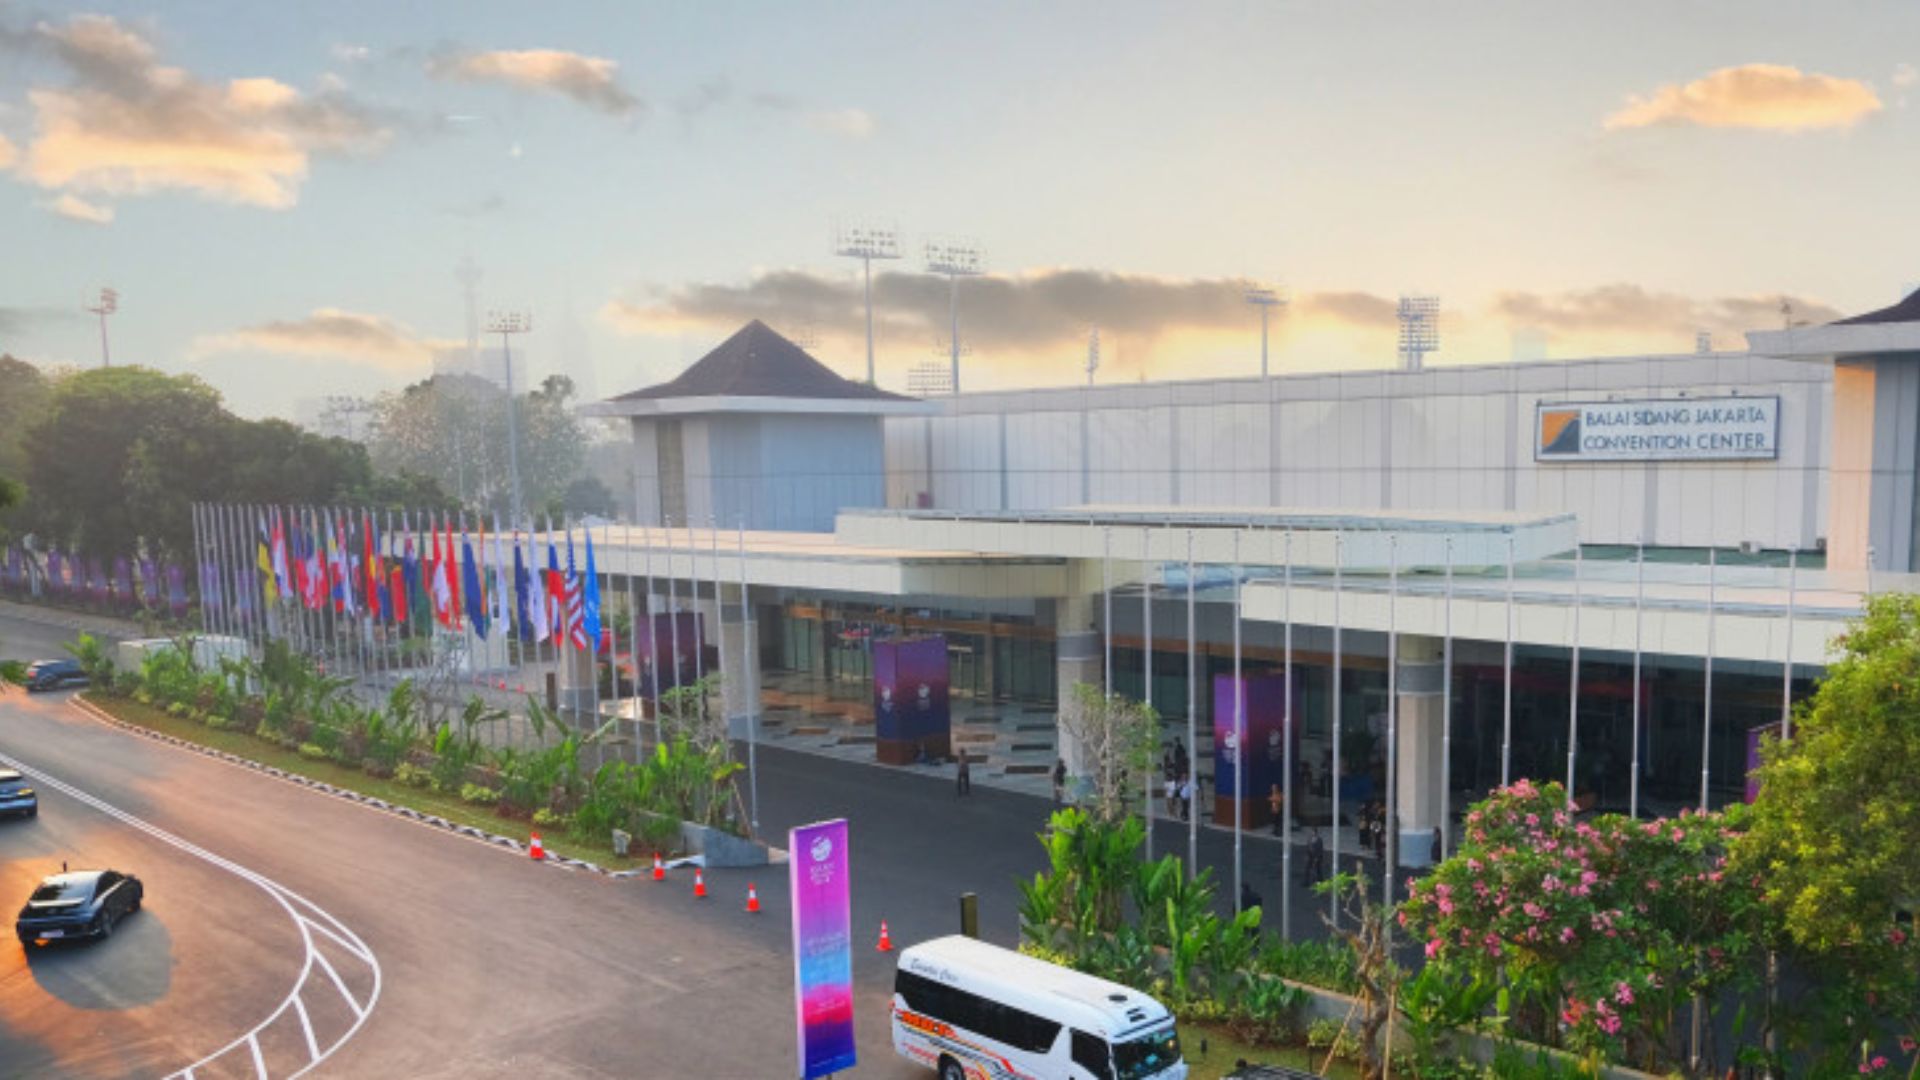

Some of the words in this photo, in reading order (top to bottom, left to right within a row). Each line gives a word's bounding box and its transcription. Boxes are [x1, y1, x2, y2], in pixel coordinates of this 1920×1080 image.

[1586, 411, 1630, 426] BALAI
[1633, 409, 1690, 426] SIDANG
[1695, 406, 1766, 424] JAKARTA
[1583, 434, 1690, 450] CONVENTION
[1696, 432, 1765, 449] CENTER
